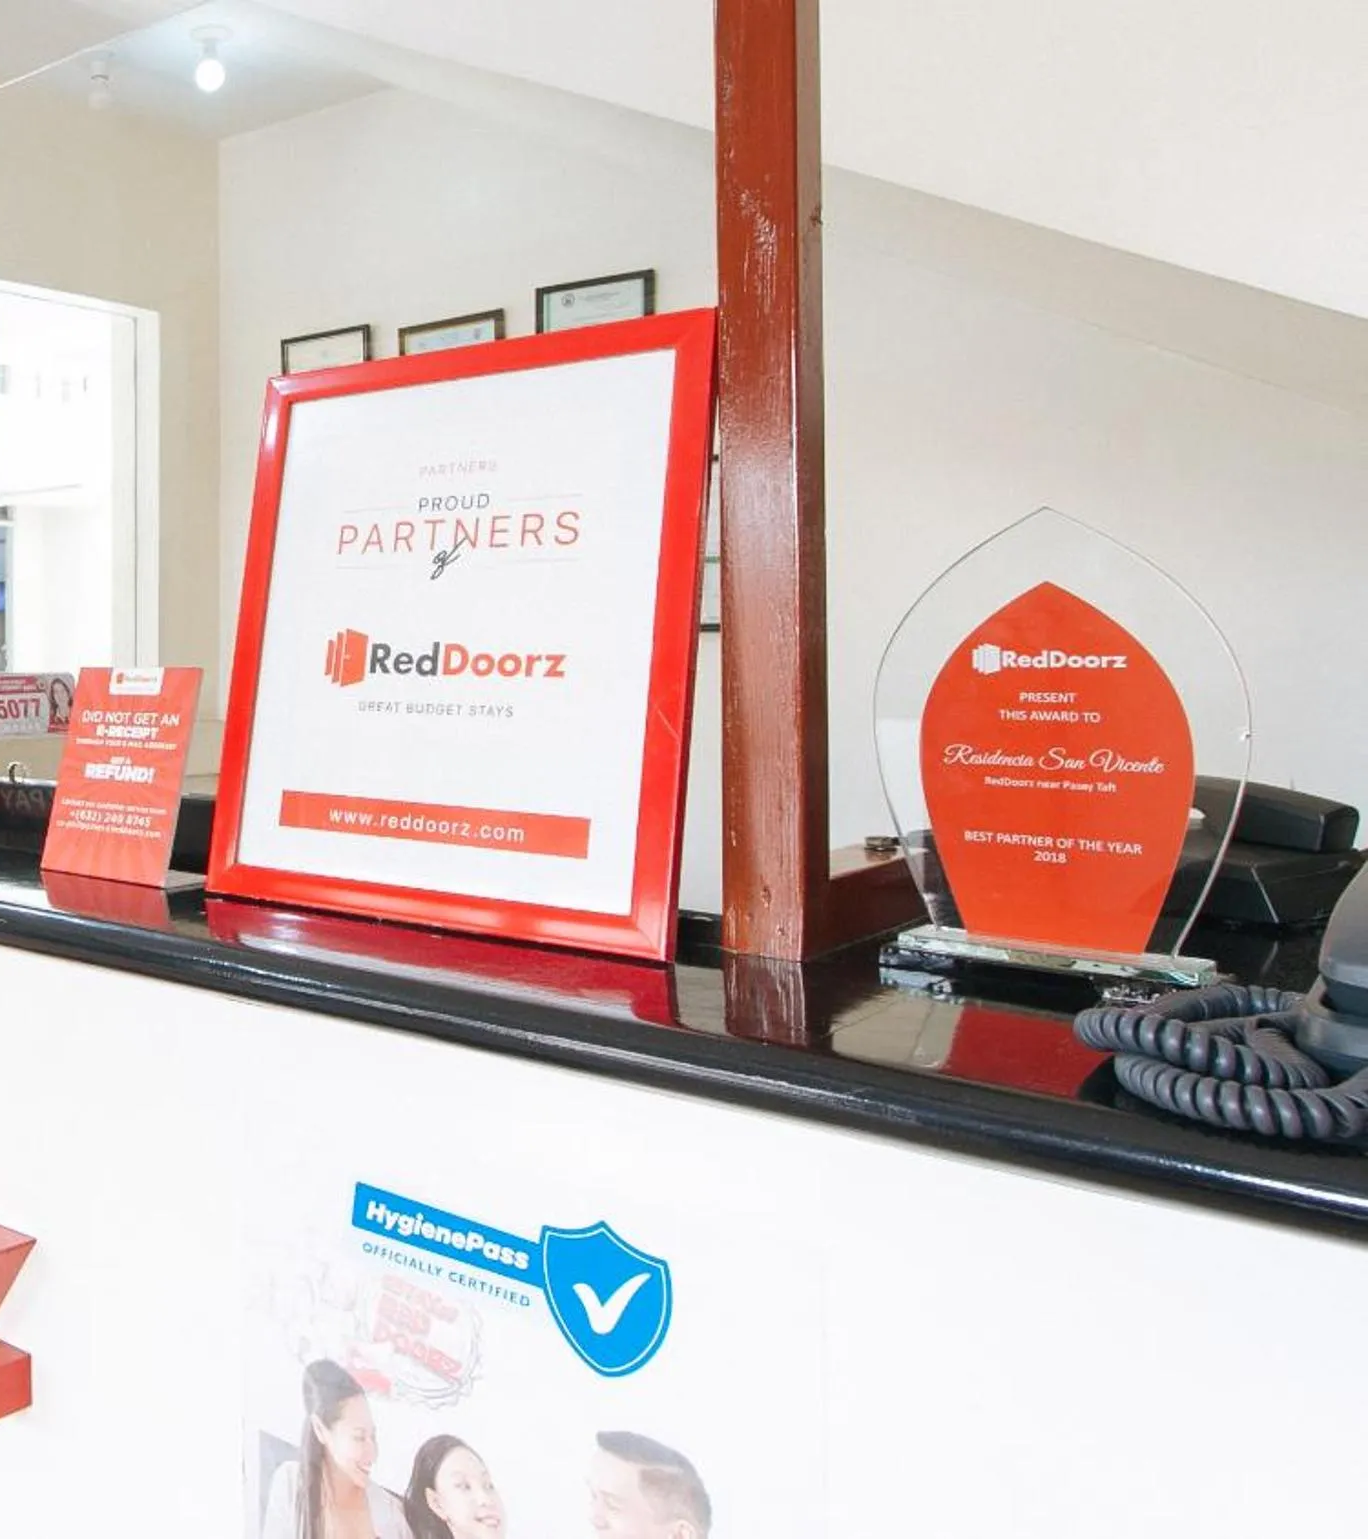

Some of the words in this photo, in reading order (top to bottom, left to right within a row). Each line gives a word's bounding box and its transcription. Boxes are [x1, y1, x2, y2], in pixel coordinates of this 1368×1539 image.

[418, 493, 491, 513] PROUD
[337, 511, 581, 556] PARTNERS
[429, 533, 468, 581] of
[368, 641, 567, 678] RedDoorz
[1001, 650, 1127, 669] RedDoorz
[1019, 691, 1077, 704] PRESENT
[82, 709, 103, 724] DID
[105, 710, 131, 725] NOT
[134, 712, 159, 725] GET
[160, 713, 180, 727] AN
[357, 701, 401, 713] GREAT
[406, 702, 463, 716] BUDGET
[468, 704, 514, 718] STAYS
[998, 709, 1027, 722] THIS
[1030, 710, 1079, 723] AWARD
[1083, 711, 1101, 723] TO
[943, 743, 1033, 767] Residencia
[1038, 746, 1085, 771] San
[1089, 748, 1165, 774] Vicente
[84, 762, 155, 784] REFUND!
[1036, 779, 1061, 789] near
[1096, 781, 1117, 793] Taft
[328, 807, 525, 844] www.reddoorz.com
[963, 830, 993, 843] BEST
[996, 833, 1054, 848] PARTNER
[1056, 837, 1075, 850] OF
[1079, 839, 1105, 852] THE
[1107, 841, 1143, 855] YEAR
[1033, 850, 1067, 864] 2018
[365, 1200, 530, 1270] HygienePass
[362, 1242, 444, 1277] OFFICIALLY
[447, 1271, 531, 1307] CERTIFIED
